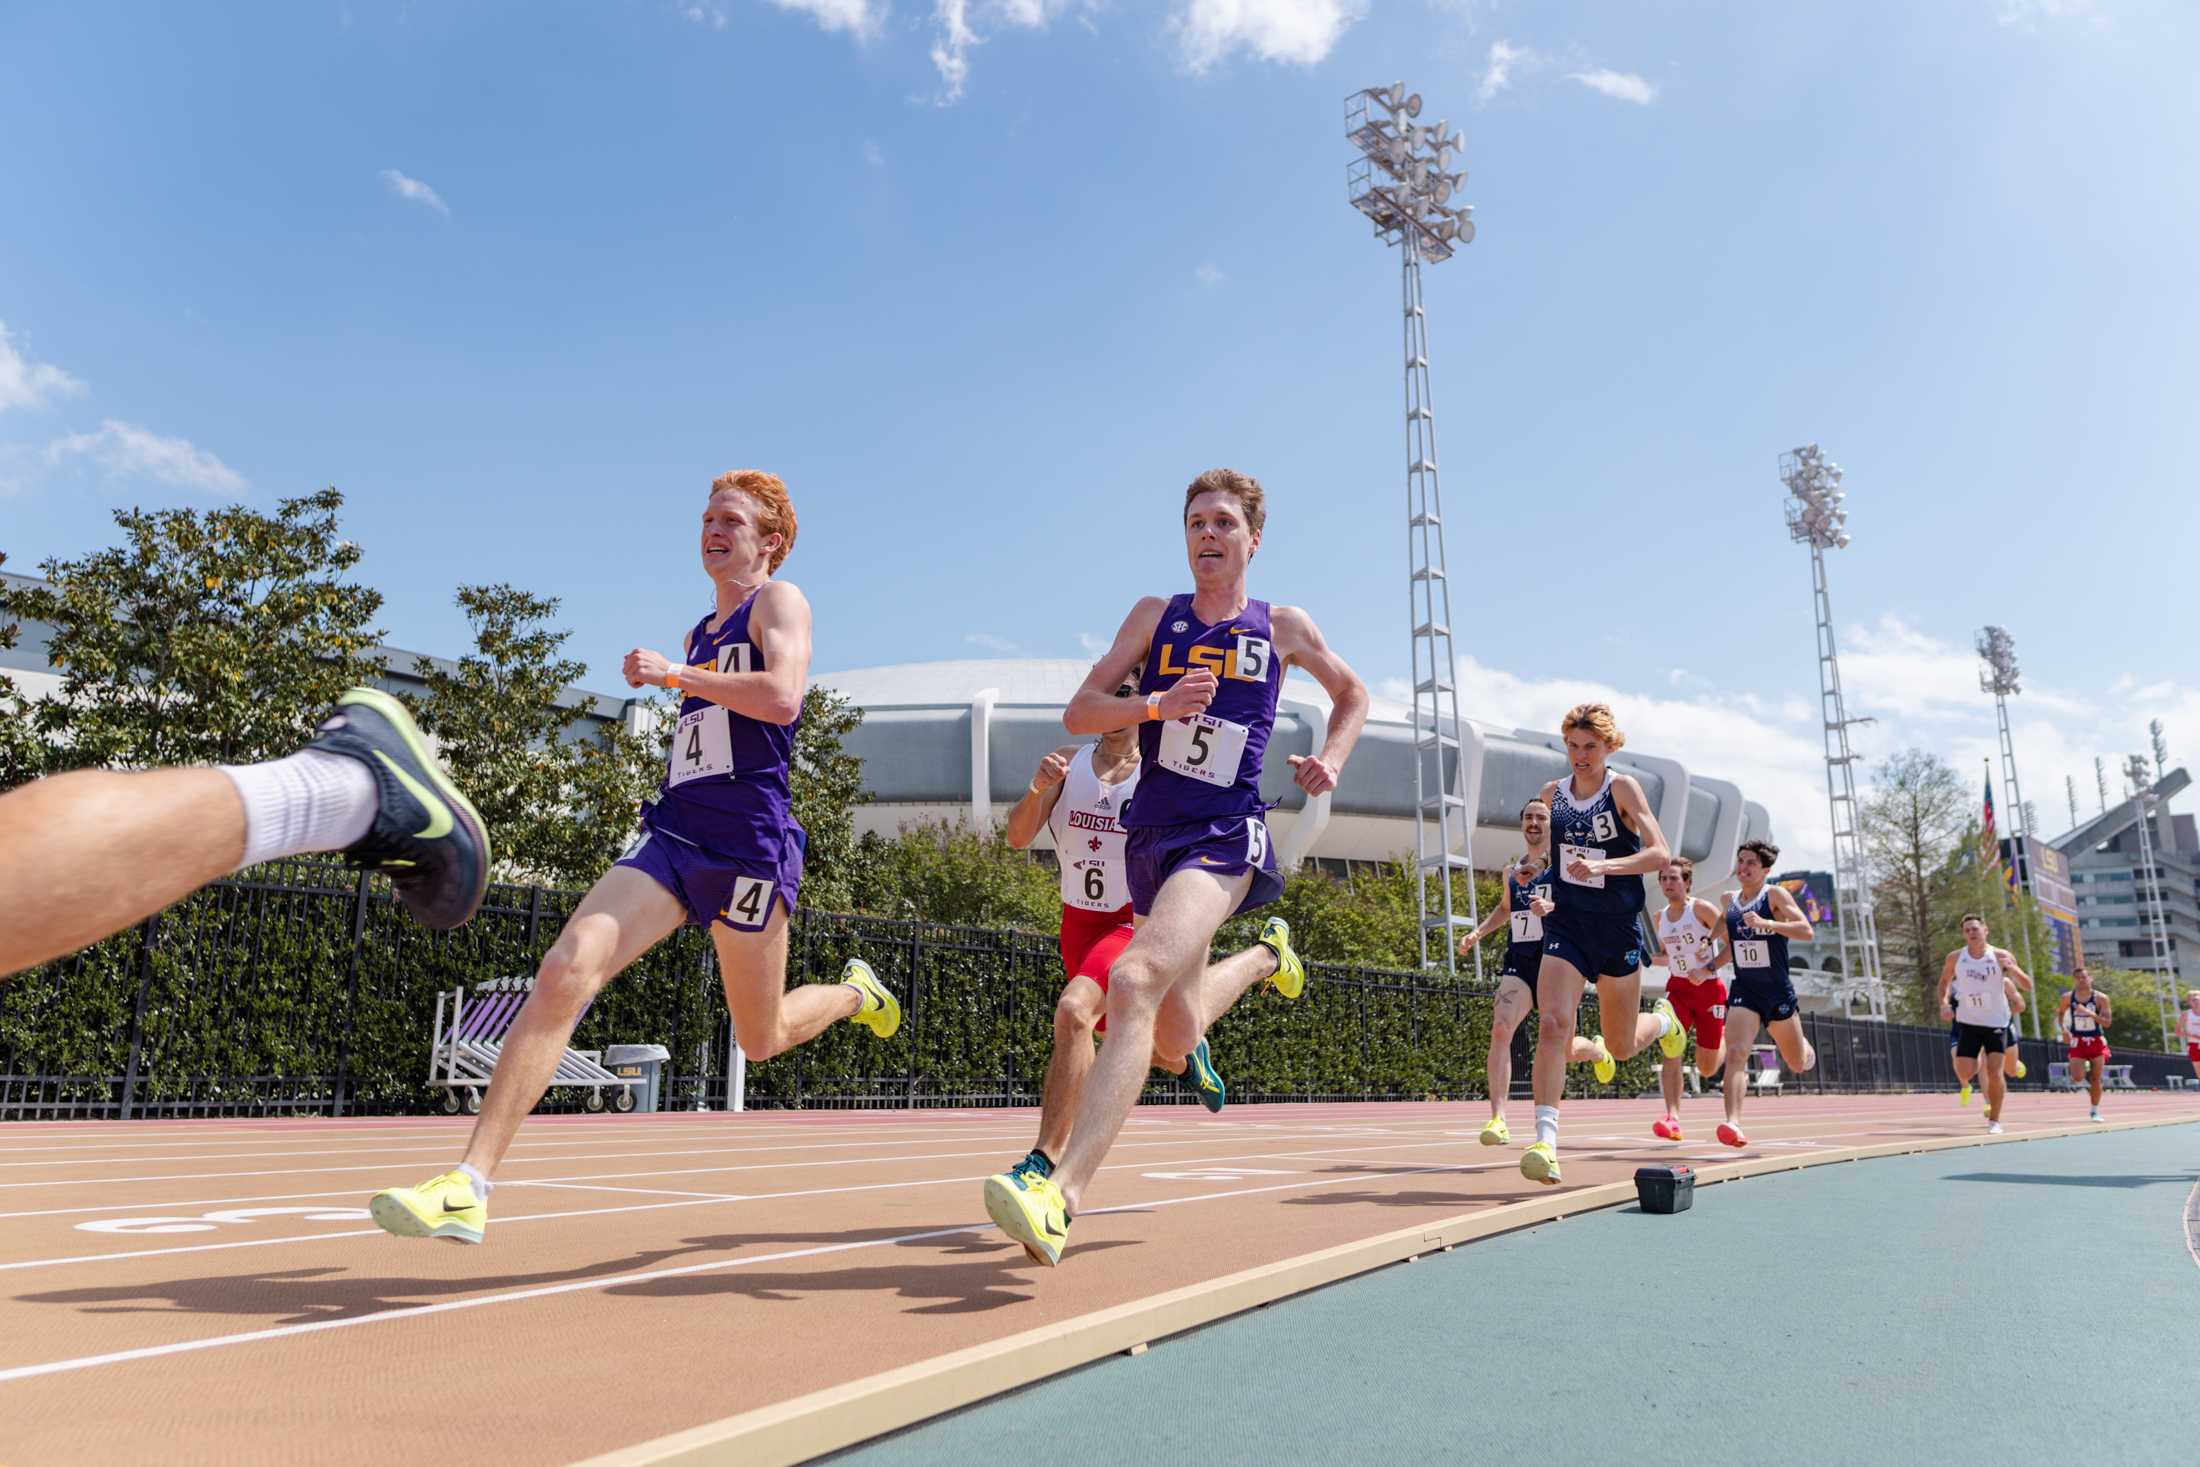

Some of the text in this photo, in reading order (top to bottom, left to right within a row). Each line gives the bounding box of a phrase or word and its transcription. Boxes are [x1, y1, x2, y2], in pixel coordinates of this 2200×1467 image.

[1244, 640, 1262, 677] 5
[684, 711, 704, 727] LSU
[686, 724, 703, 766] 4
[1186, 725, 1214, 766] 5
[1173, 760, 1215, 779] TIGERS
[1597, 814, 1612, 839] 3
[1251, 822, 1263, 863] 5
[1085, 868, 1104, 900] 6
[1538, 886, 1547, 899] 7
[736, 882, 764, 922] 4
[1521, 917, 1529, 936] 7
[1682, 933, 1694, 945] 13
[1743, 949, 1757, 961] 10
[1677, 960, 1687, 971] 13
[1972, 997, 1982, 1007] 11
